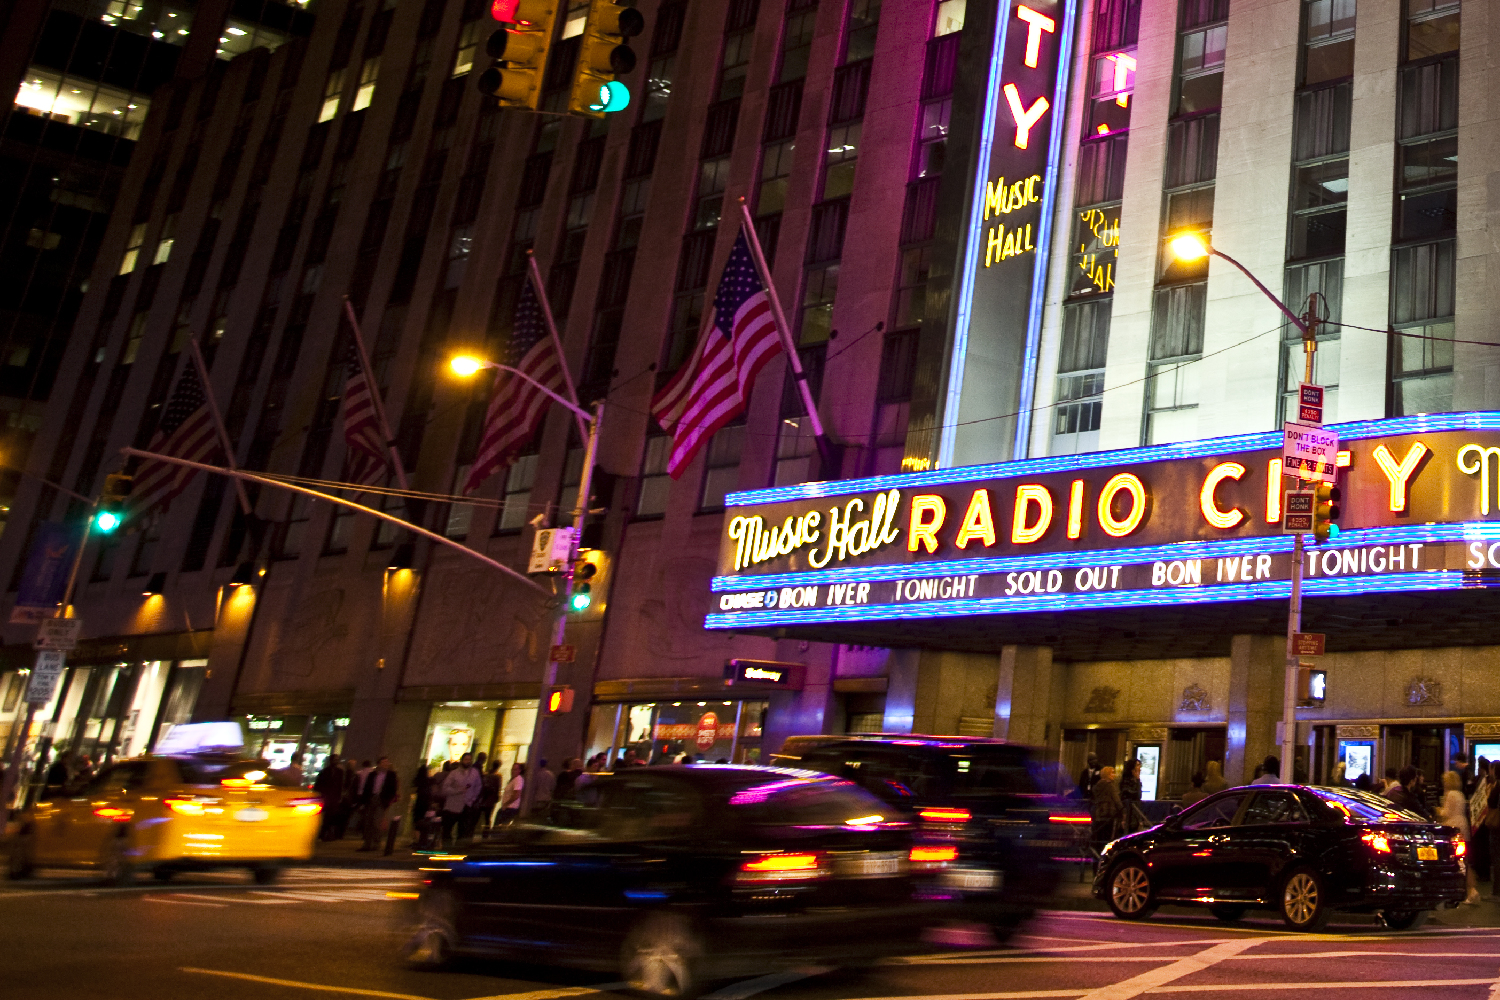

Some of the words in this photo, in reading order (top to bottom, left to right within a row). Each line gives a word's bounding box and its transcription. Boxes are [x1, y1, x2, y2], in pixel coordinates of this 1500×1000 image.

[984, 174, 1041, 221] MUSIC
[985, 223, 1034, 268] HALL
[1303, 395, 1320, 403] HONK
[1287, 430, 1309, 441] DON'T
[1310, 434, 1335, 448] BLOCK
[1296, 442, 1310, 453] THE
[1311, 446, 1326, 456] BOX
[728, 510, 821, 571] Music
[808, 488, 900, 569] Hall
[906, 471, 1148, 554] RADIO
[1200, 439, 1433, 530] CIY
[778, 586, 819, 609] BON
[826, 582, 871, 605] IVER
[895, 574, 979, 601] TONIGHT
[1003, 568, 1063, 597] SOLD
[1074, 564, 1122, 592] OUT
[1151, 559, 1201, 587] BON
[1216, 553, 1272, 582] IVER
[1306, 542, 1423, 577] TONIGHT
